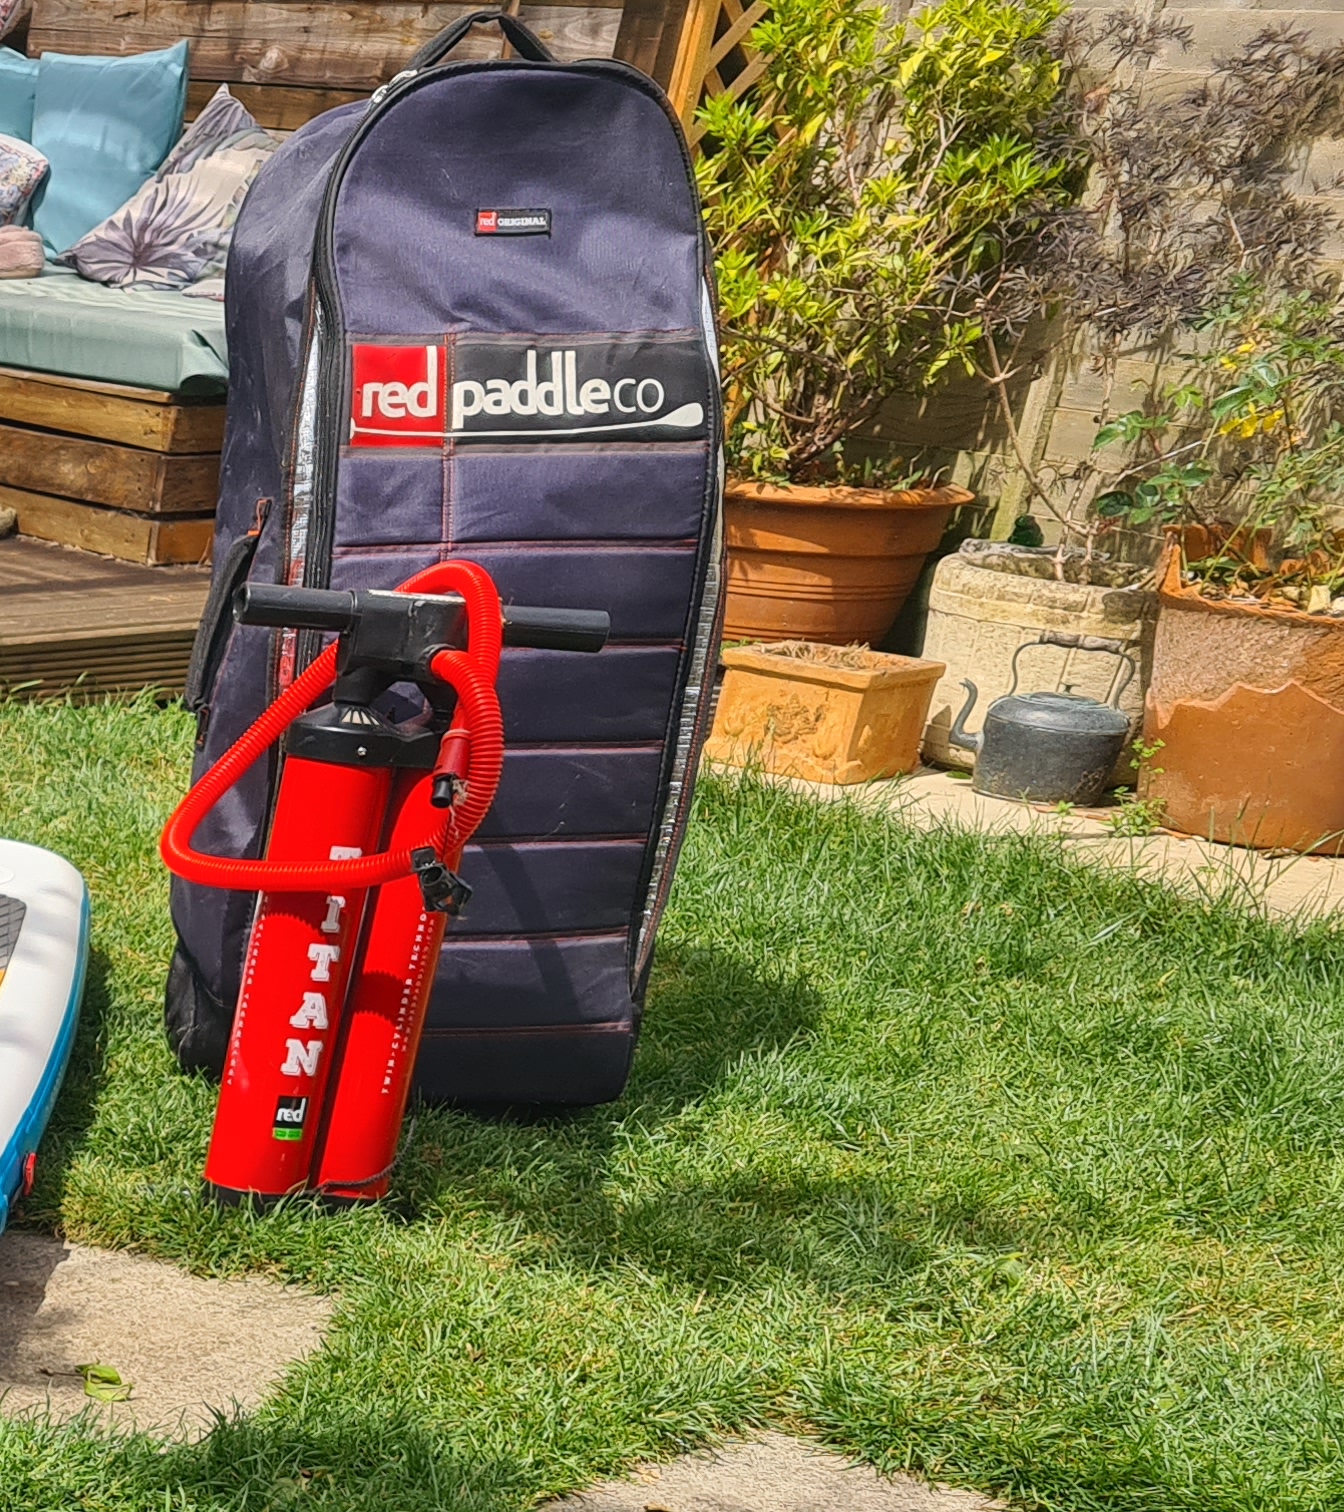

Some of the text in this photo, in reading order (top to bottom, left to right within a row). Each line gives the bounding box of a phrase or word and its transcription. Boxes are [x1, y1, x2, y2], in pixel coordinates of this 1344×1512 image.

[479, 212, 546, 227] red ORIGINAL
[362, 346, 438, 418] red
[409, 906, 427, 970] TECHNO
[276, 1098, 306, 1122] red
